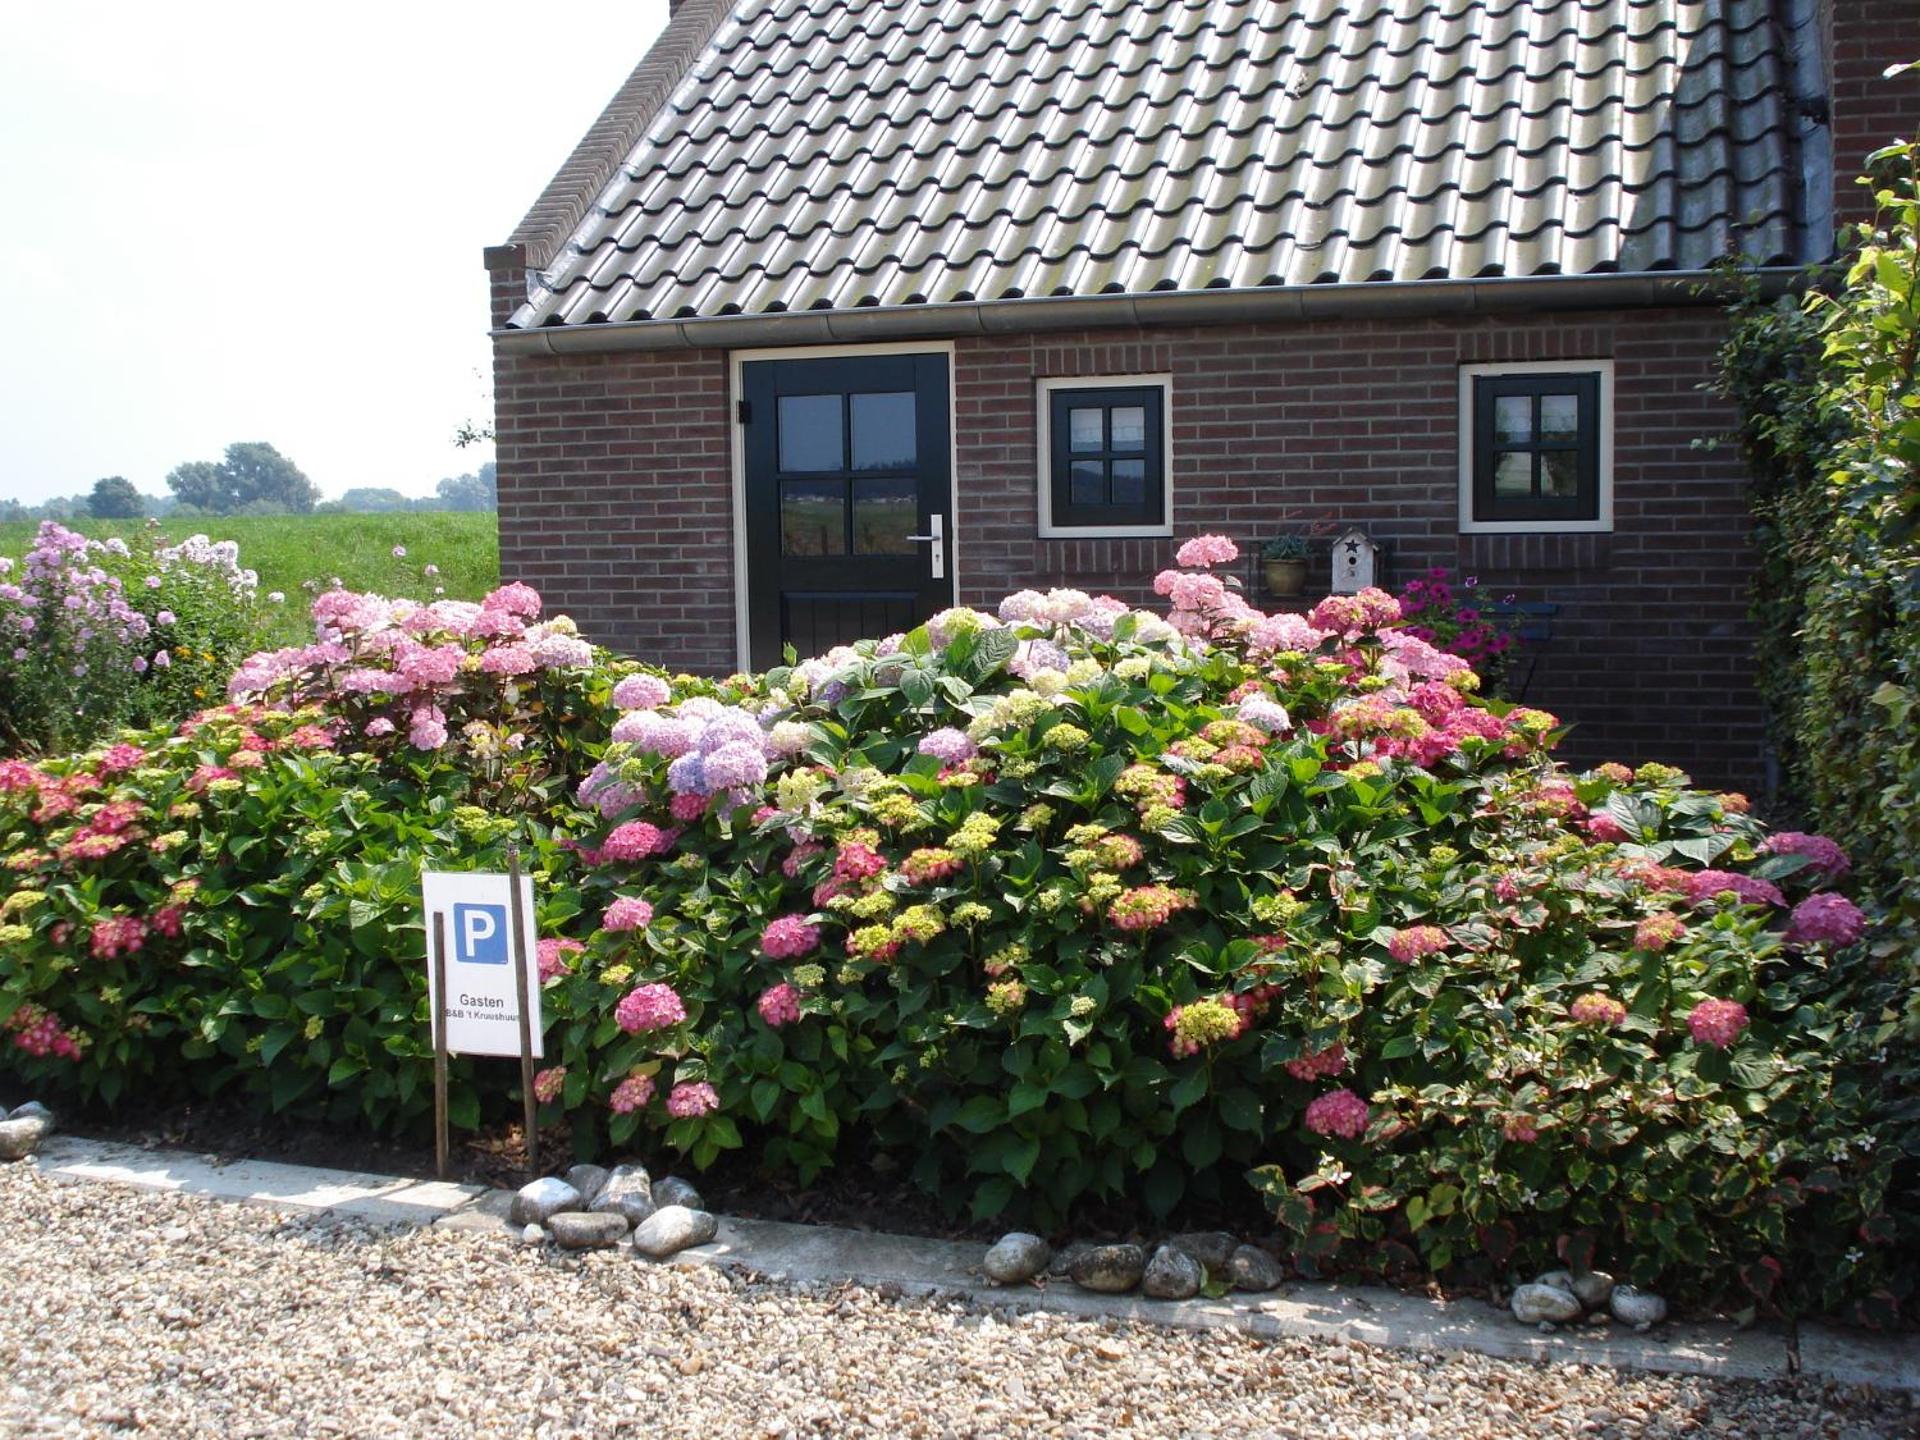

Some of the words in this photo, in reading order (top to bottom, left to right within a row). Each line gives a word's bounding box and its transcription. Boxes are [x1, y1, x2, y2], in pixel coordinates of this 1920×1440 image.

[464, 910, 495, 957] P
[459, 993, 504, 1008] Gasten
[445, 1008, 464, 1018] B&B
